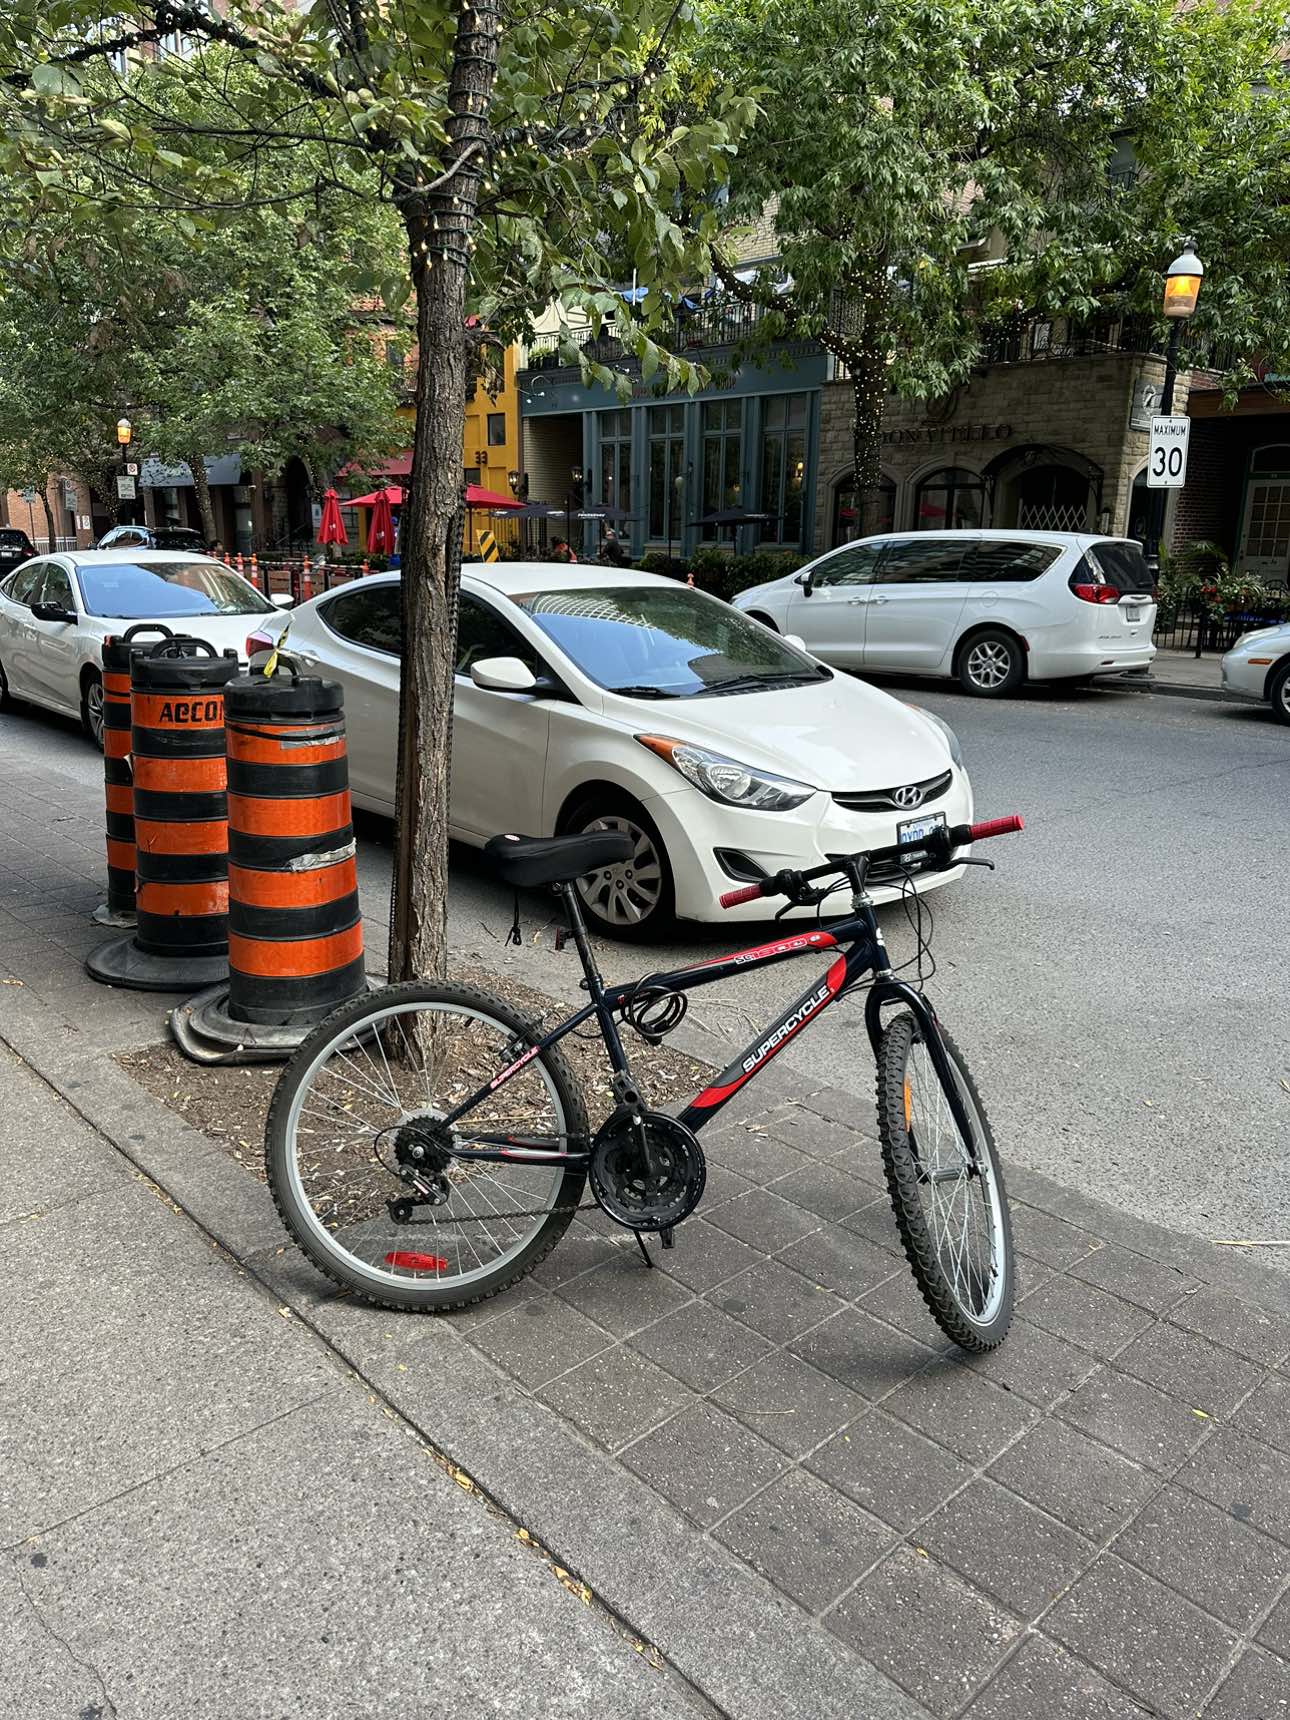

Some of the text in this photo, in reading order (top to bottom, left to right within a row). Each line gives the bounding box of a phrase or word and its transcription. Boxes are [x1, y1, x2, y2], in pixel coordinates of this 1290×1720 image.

[1154, 425, 1186, 436] MAXIMUM
[475, 451, 488, 465] 33
[1152, 447, 1183, 477] 30
[742, 985, 830, 1073] SUPERCYCLE
